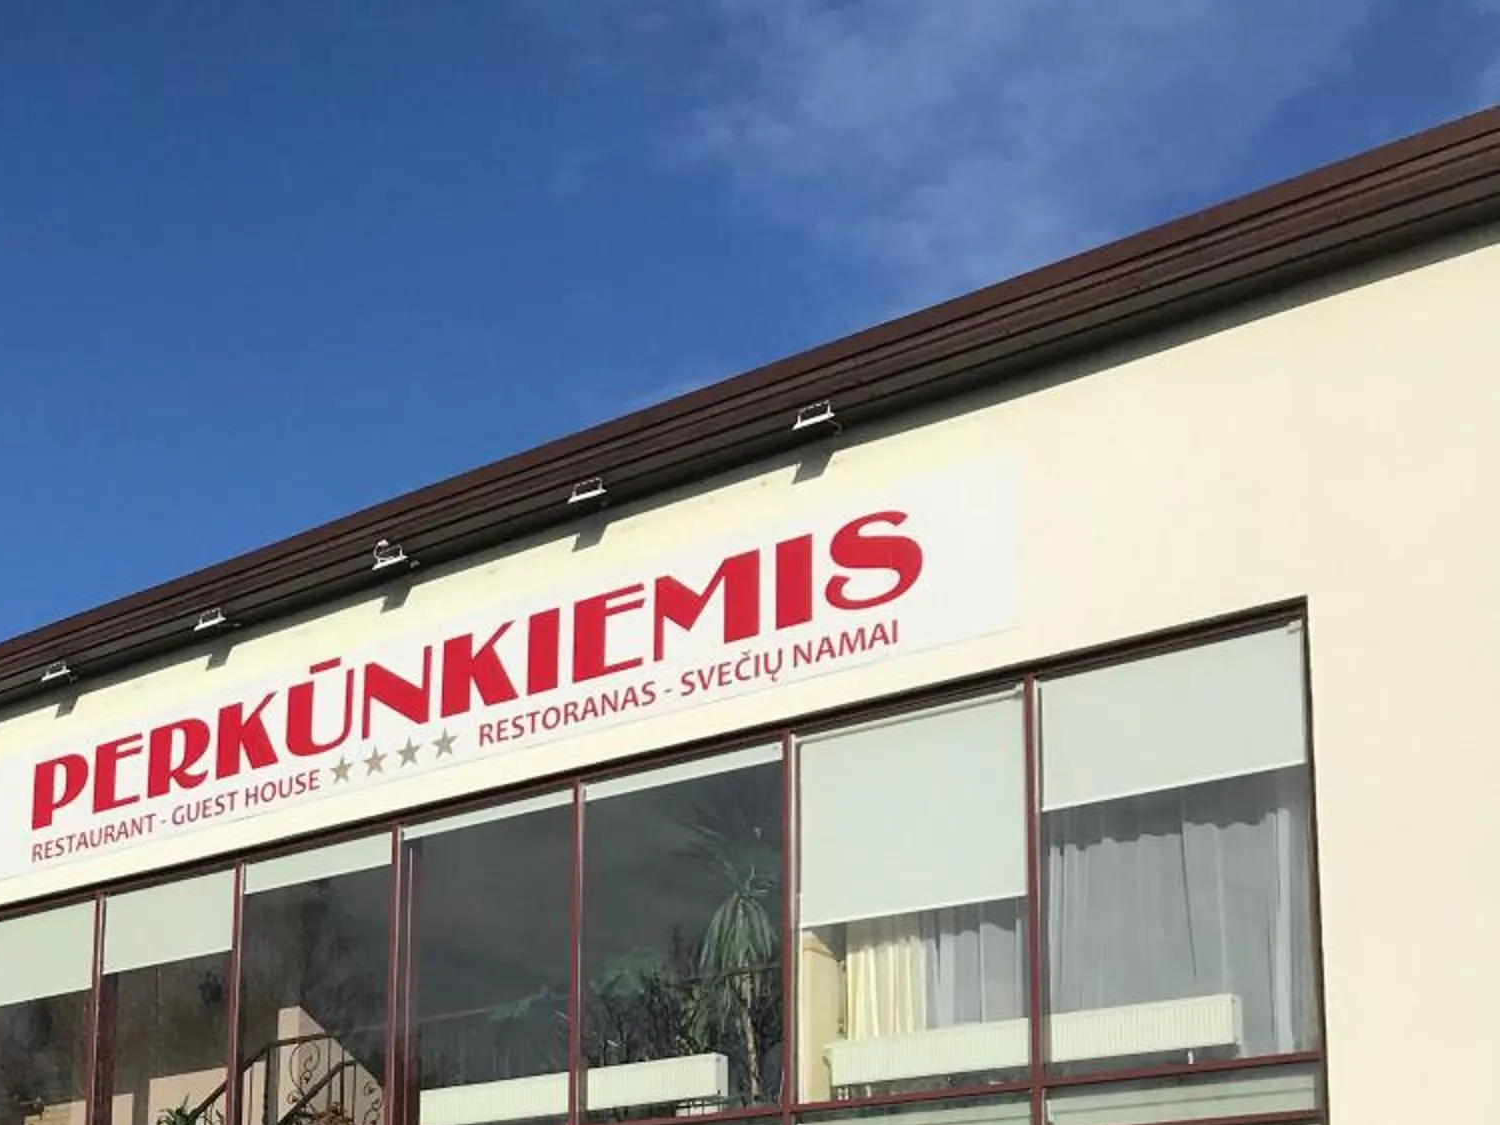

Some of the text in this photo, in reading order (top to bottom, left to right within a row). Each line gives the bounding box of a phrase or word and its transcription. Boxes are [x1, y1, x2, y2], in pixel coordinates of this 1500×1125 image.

[31, 510, 924, 831] PERKŪNKIEMIS
[478, 680, 657, 748] RESTORANAS
[680, 648, 784, 698] SVEČIŲ
[791, 619, 900, 669] NAMAI
[31, 813, 157, 863] RESTAURANT
[171, 791, 239, 827] GUEST
[244, 769, 322, 807] HOUSE
